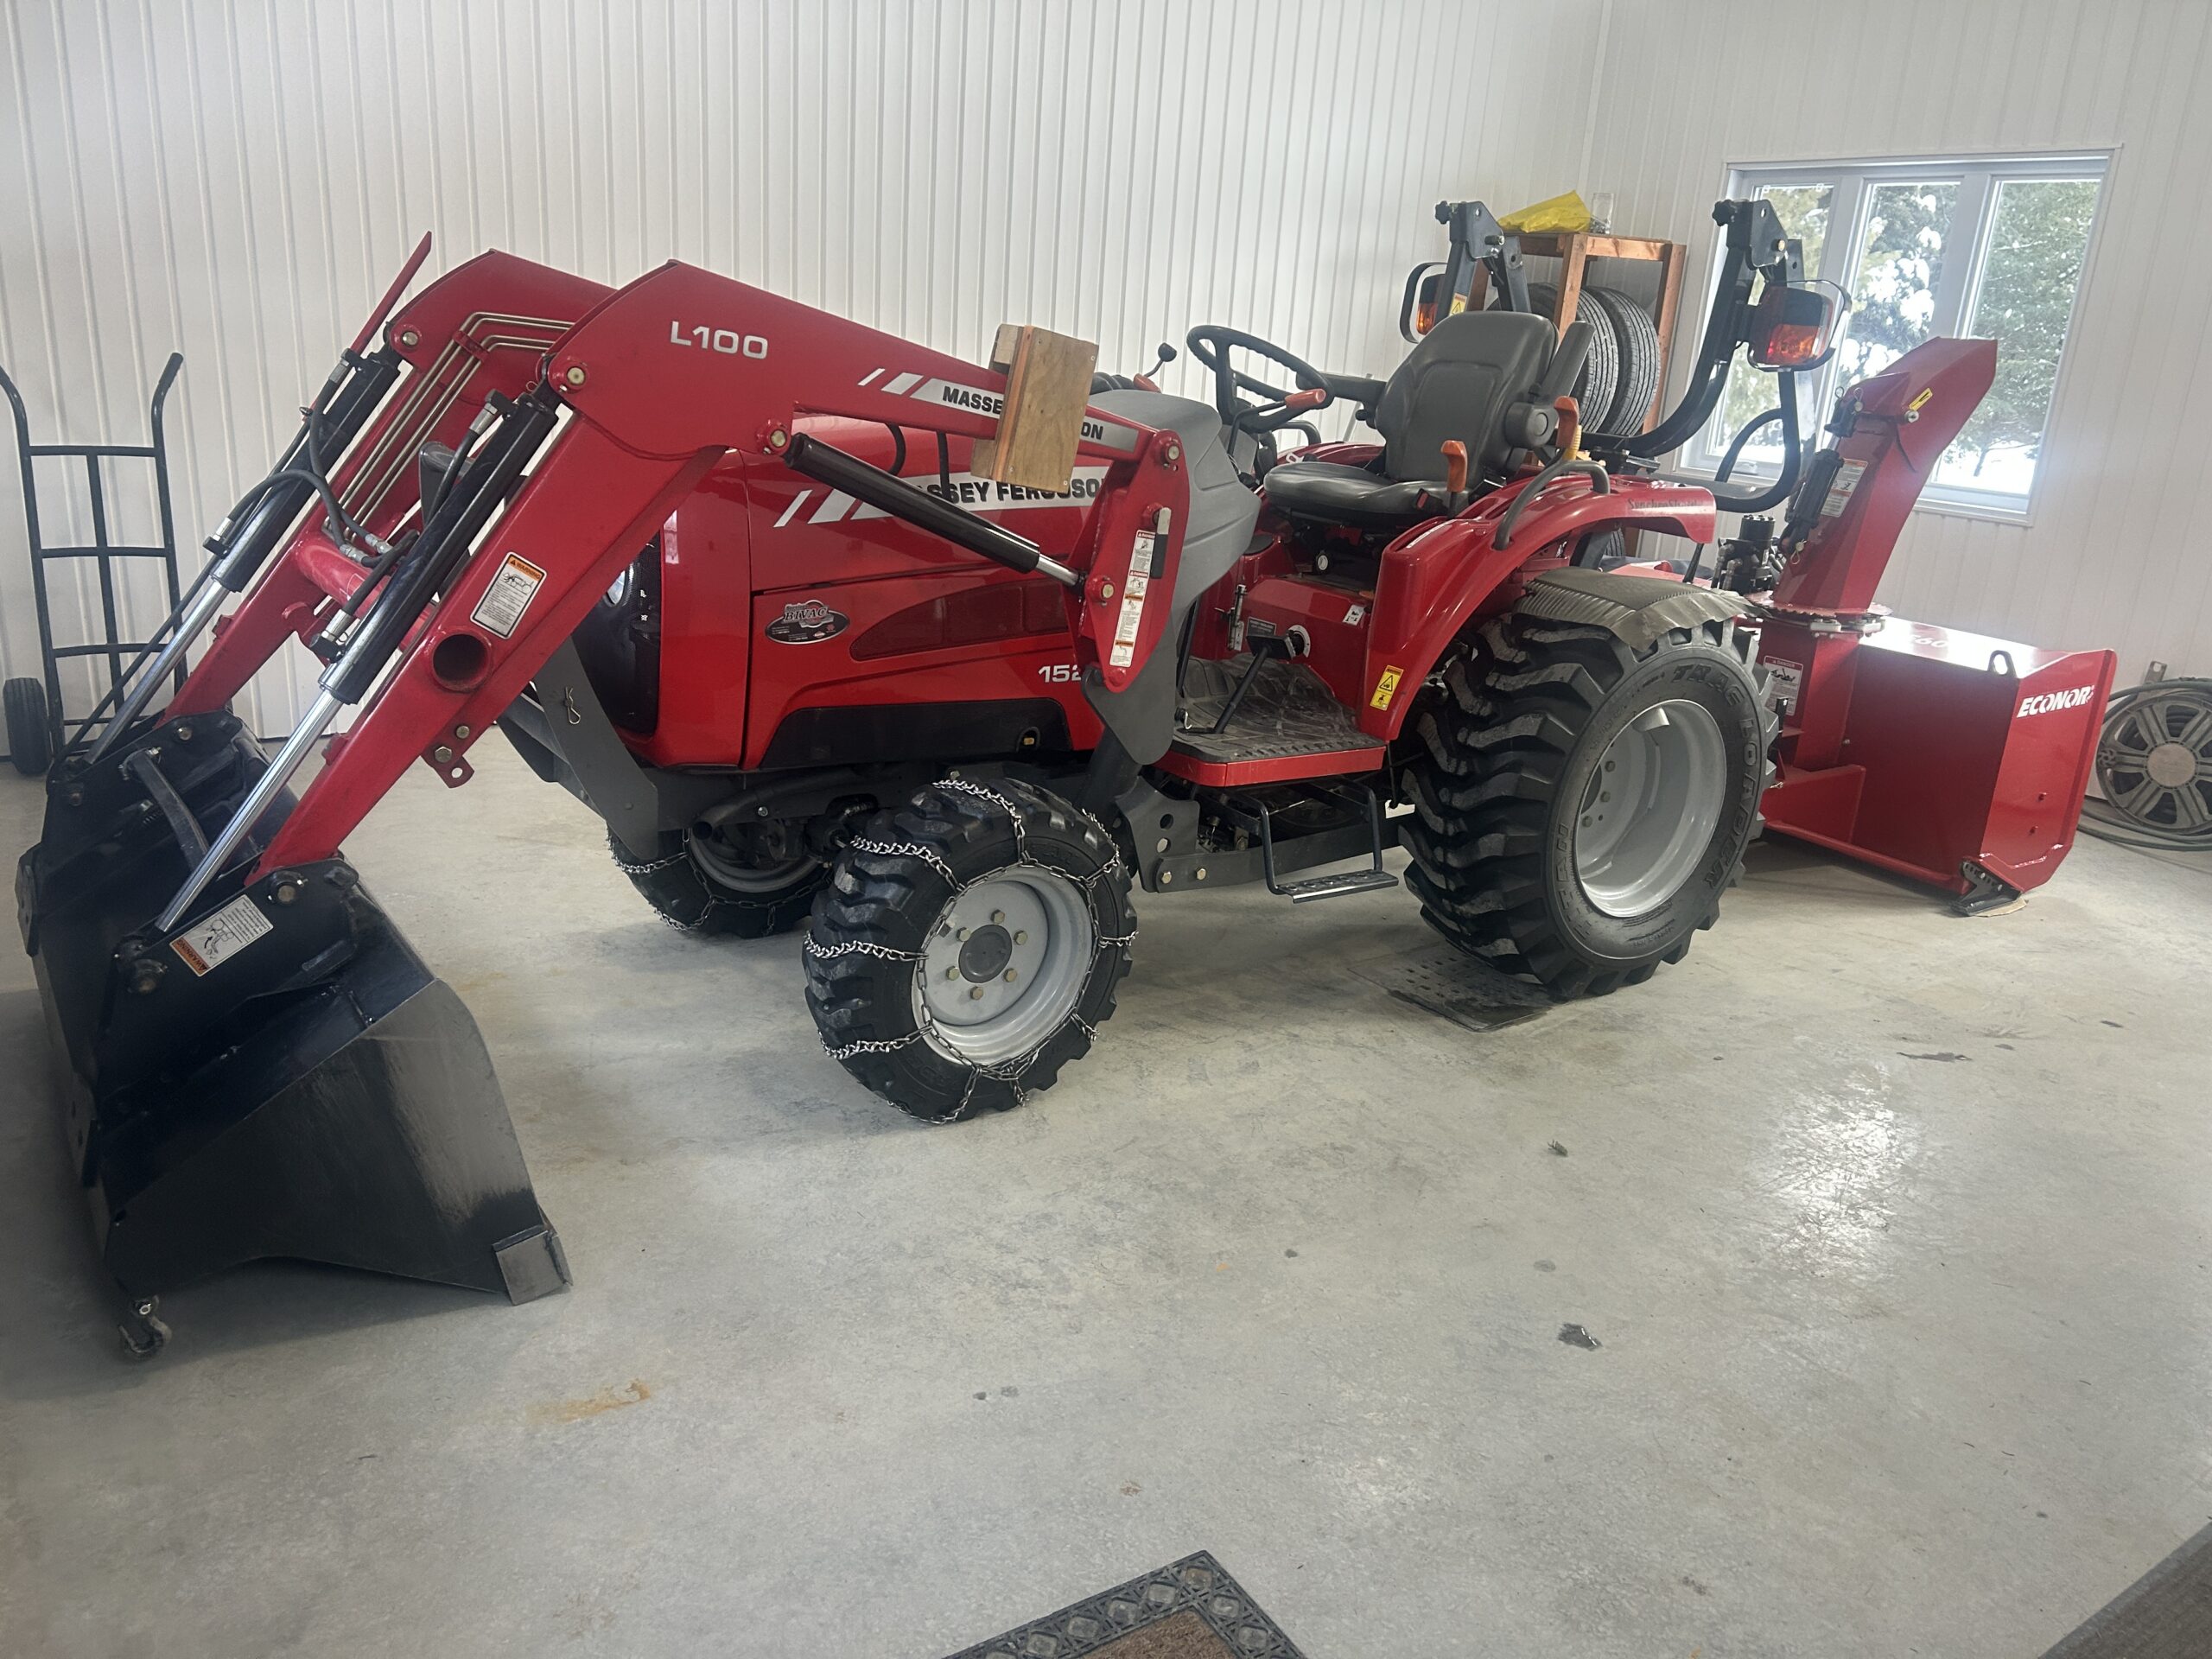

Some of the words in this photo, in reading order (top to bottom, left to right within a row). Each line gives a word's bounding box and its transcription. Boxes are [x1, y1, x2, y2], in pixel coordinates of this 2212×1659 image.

[671, 321, 768, 359] L100
[943, 386, 1002, 415] MASSE
[785, 607, 829, 621] BIVAC
[1038, 664, 1082, 683] 152
[2016, 685, 2093, 718] ECONOR
